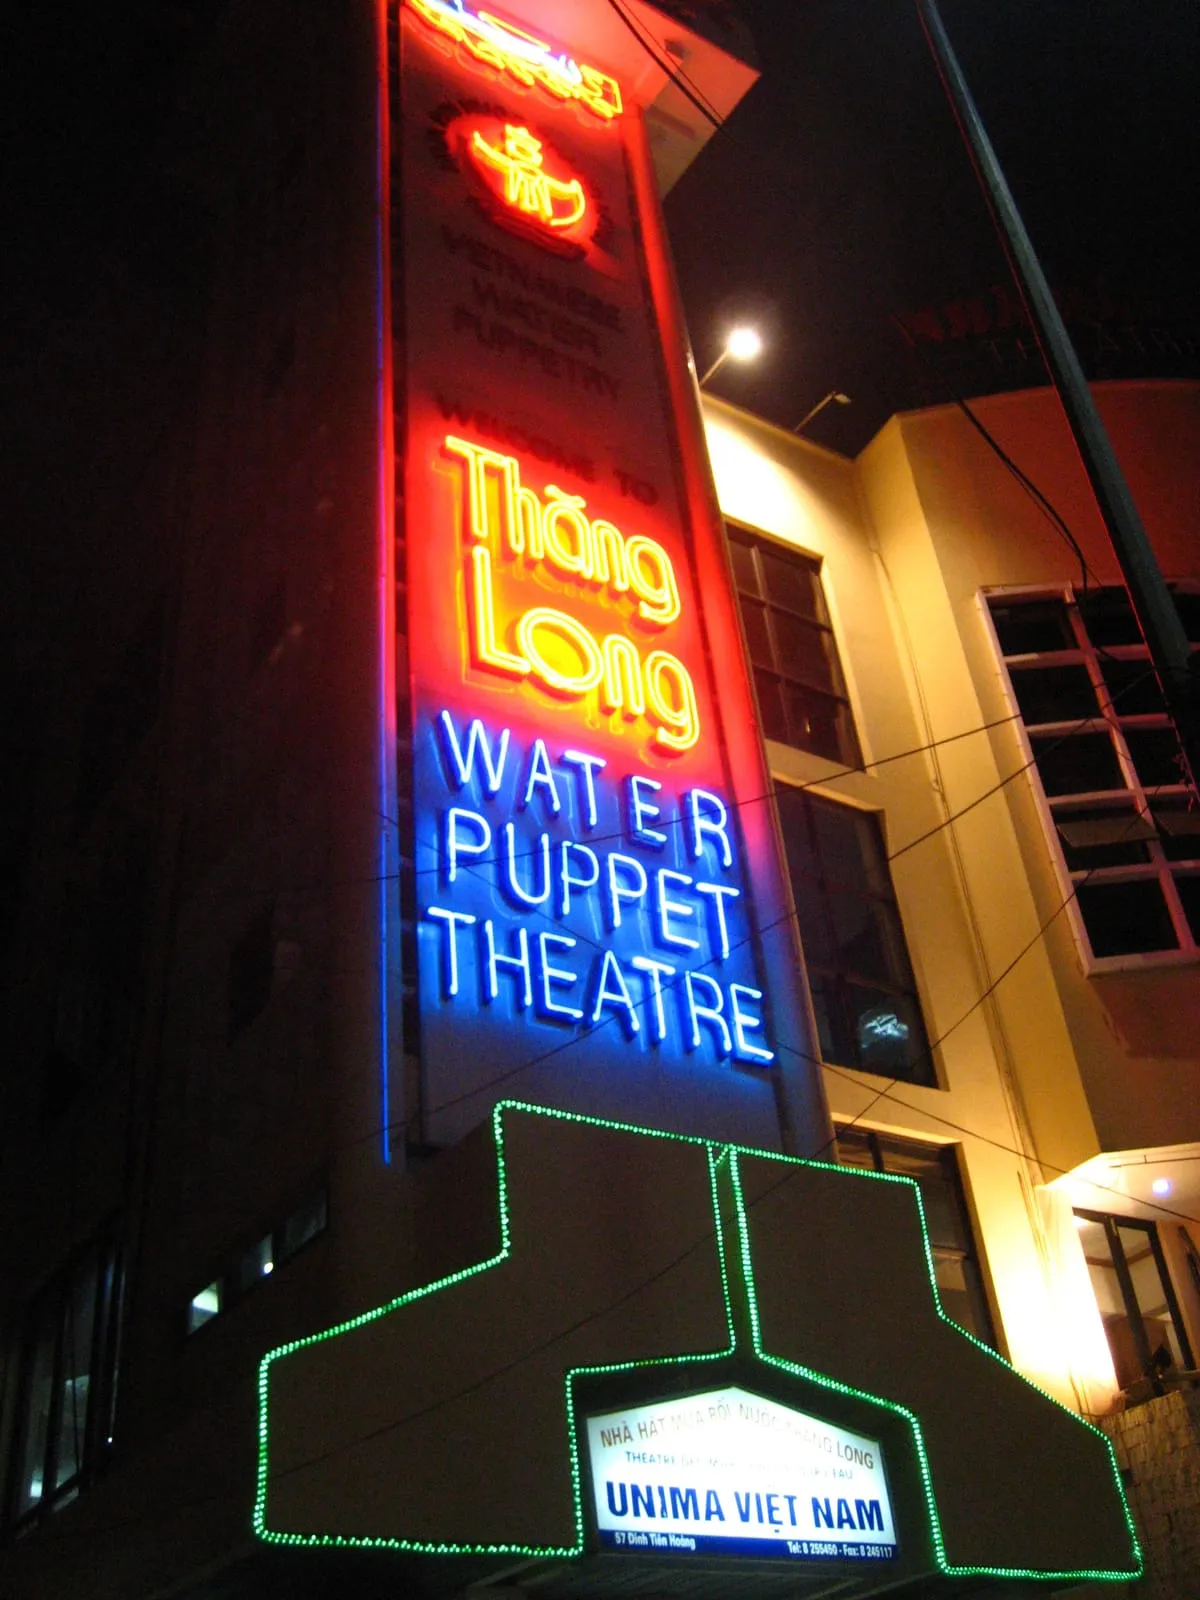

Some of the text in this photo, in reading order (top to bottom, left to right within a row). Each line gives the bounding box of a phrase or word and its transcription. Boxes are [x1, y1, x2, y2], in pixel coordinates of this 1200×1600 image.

[472, 546, 701, 751] Long
[441, 709, 733, 867] WATER
[447, 807, 740, 960] PUPPET
[427, 905, 774, 1060] THEATRE
[606, 1481, 725, 1522] UNIMA
[812, 1497, 885, 1532] NAM
[837, 1440, 874, 1469] LONG
[615, 1531, 627, 1545] 57
[787, 1540, 802, 1554] Tel:
[842, 1544, 859, 1557] Fax:
